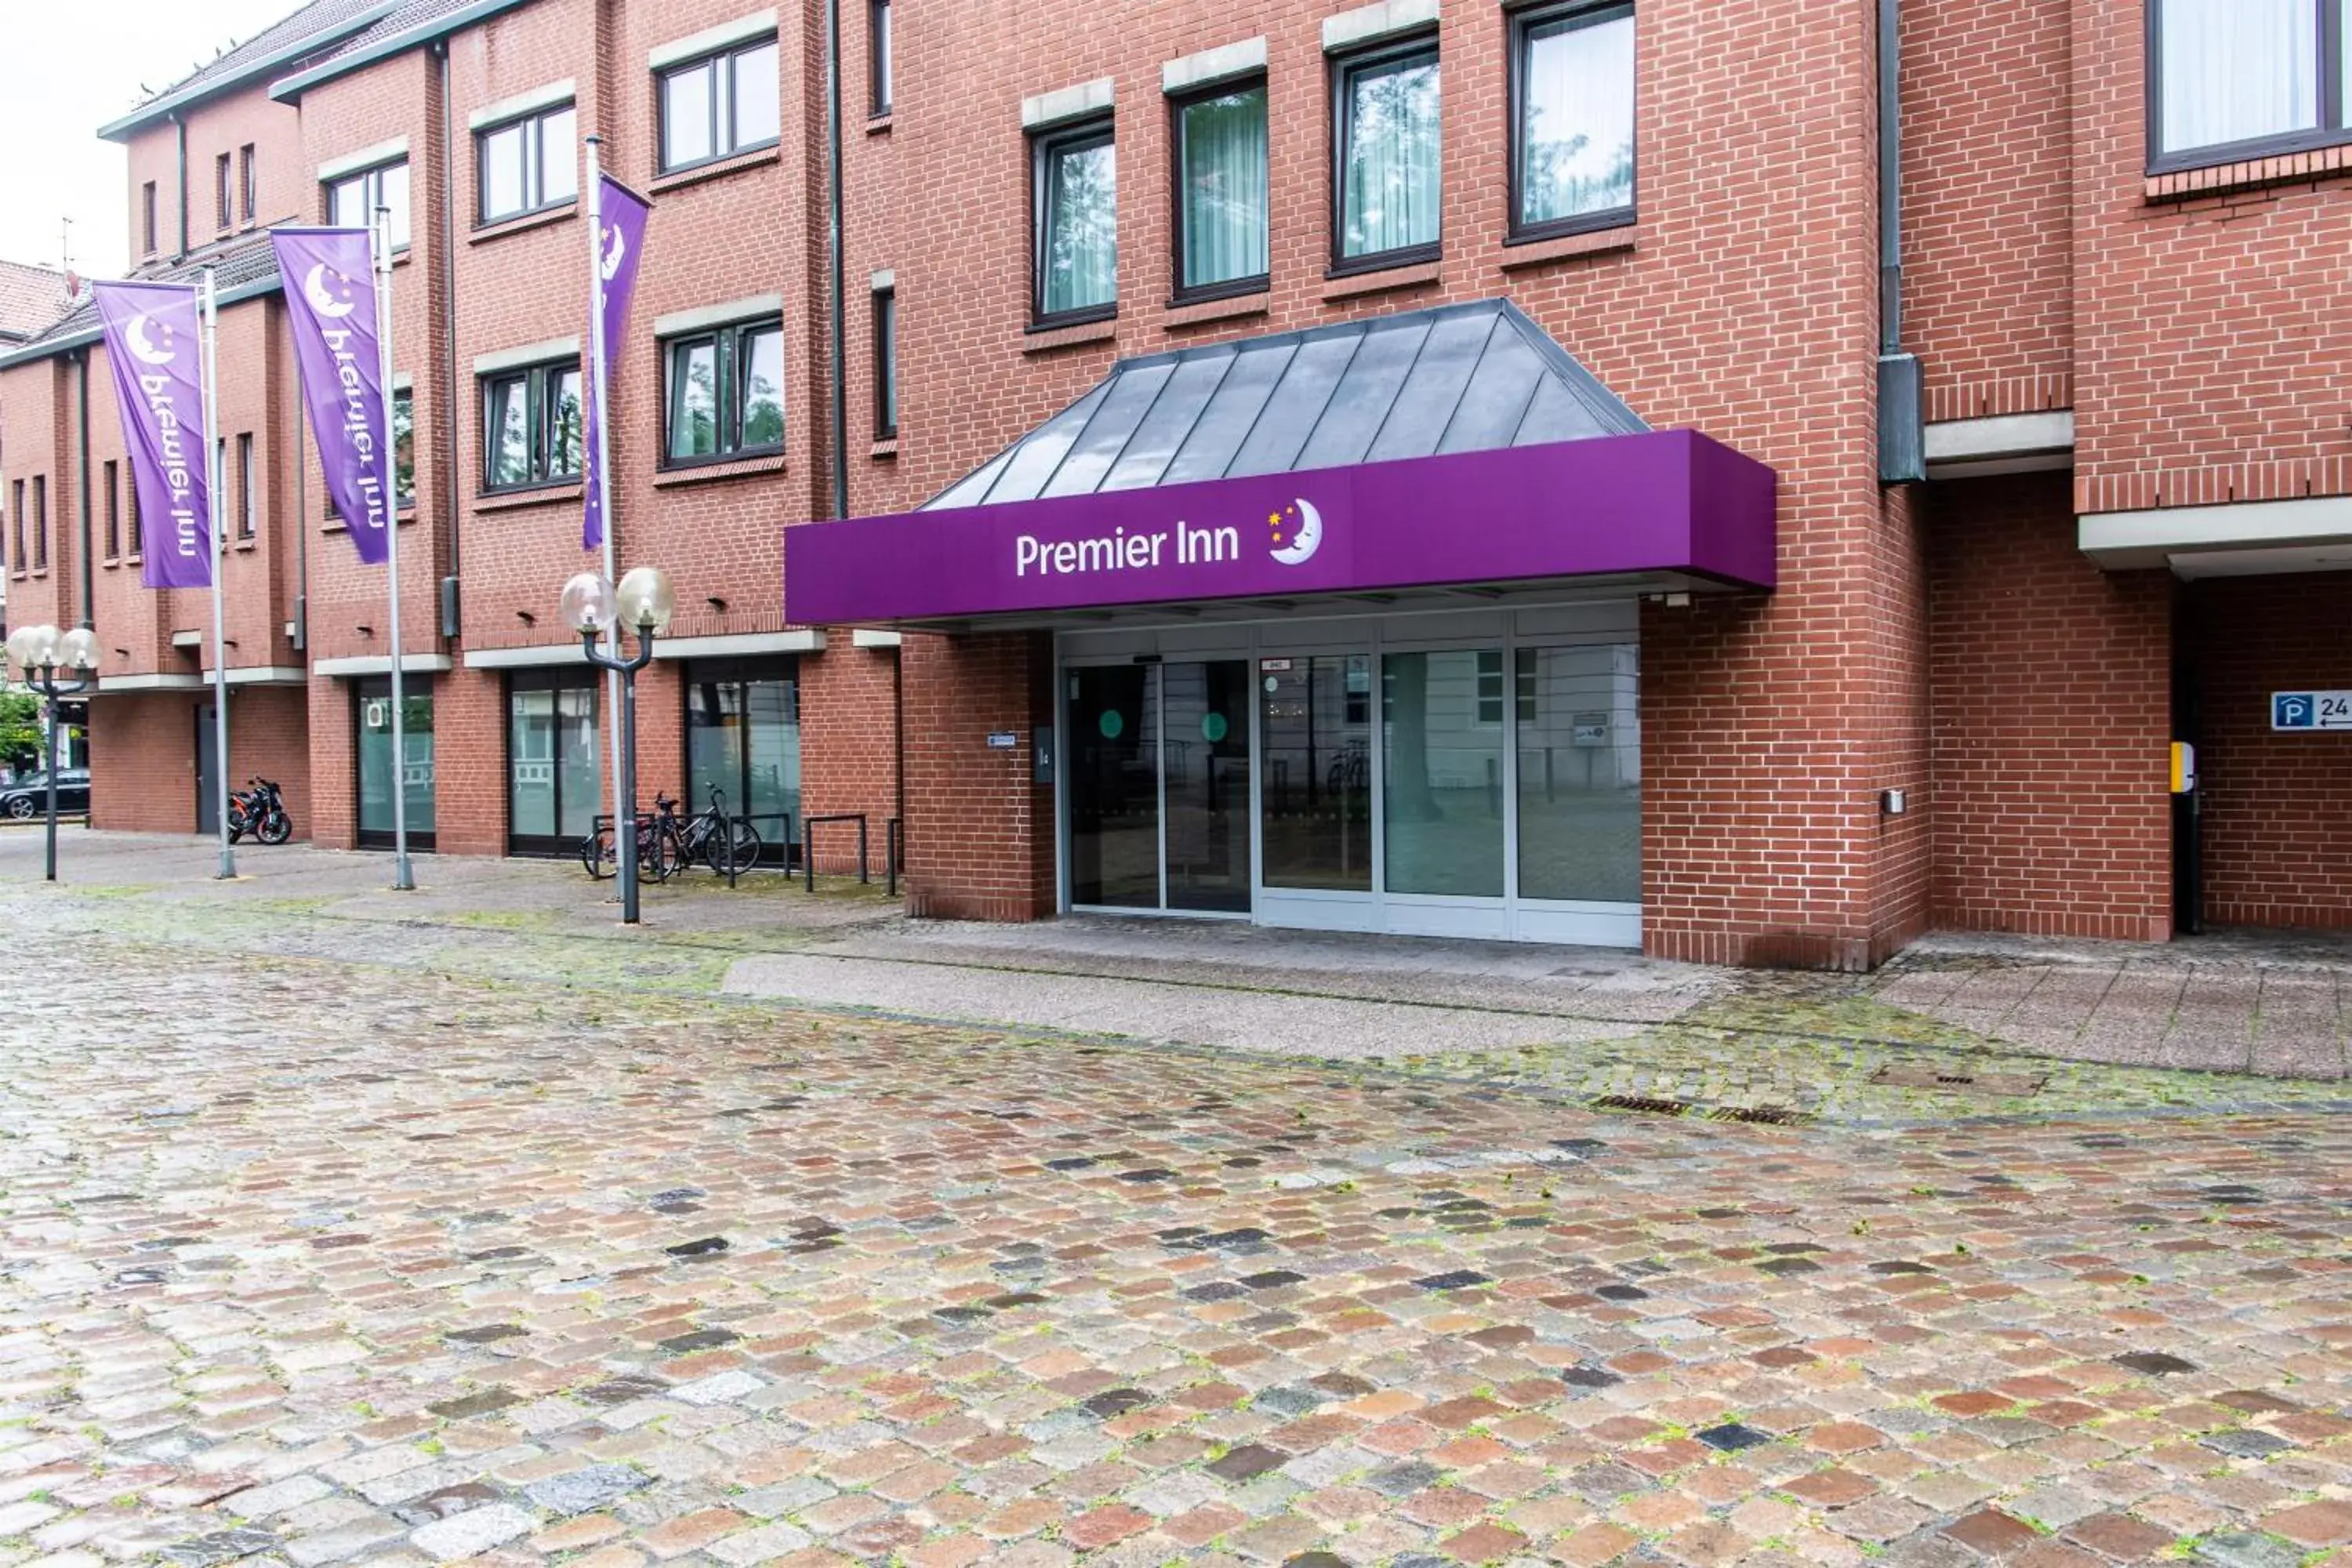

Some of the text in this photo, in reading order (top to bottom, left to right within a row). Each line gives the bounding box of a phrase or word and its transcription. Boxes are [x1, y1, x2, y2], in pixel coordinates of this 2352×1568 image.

[1016, 521, 1239, 576] Premier Inn
[2285, 699, 2347, 724] P 24
